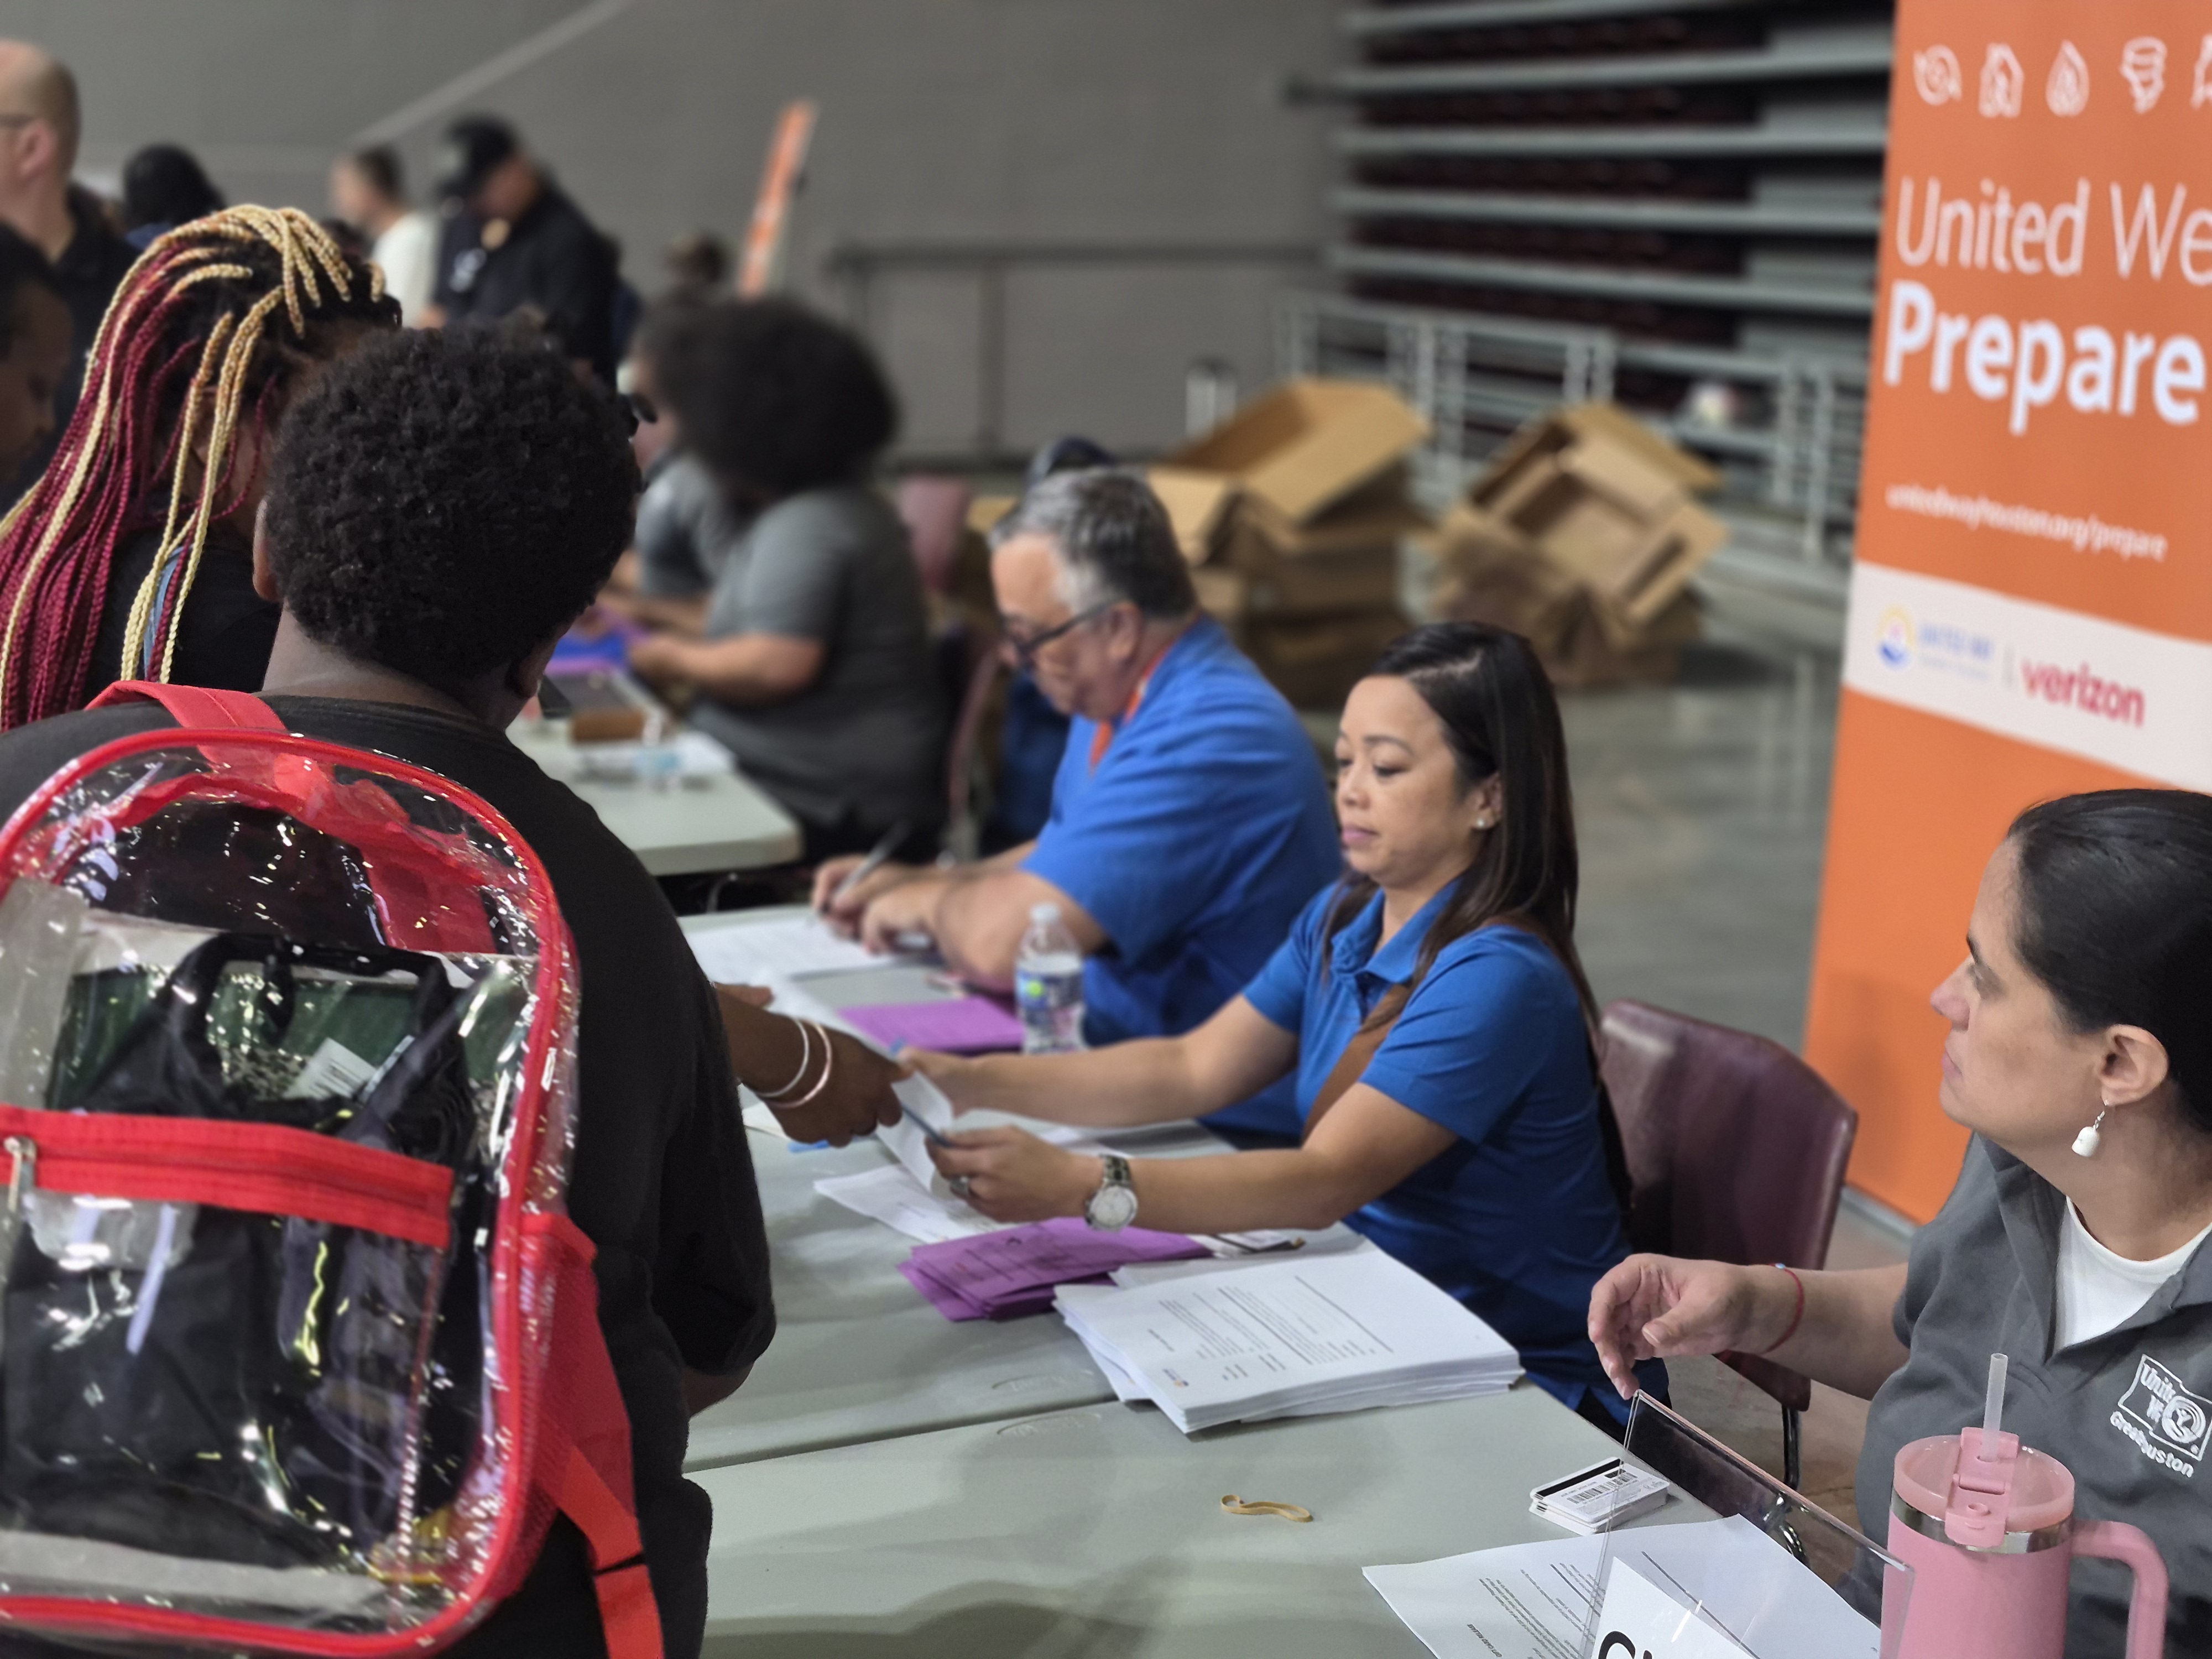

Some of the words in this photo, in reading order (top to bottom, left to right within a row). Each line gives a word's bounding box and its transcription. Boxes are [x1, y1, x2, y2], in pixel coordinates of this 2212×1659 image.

[1896, 176, 2091, 277] United
[2109, 181, 2212, 286] We
[1884, 278, 2208, 436] Prepare
[2021, 658, 2146, 728] verizon
